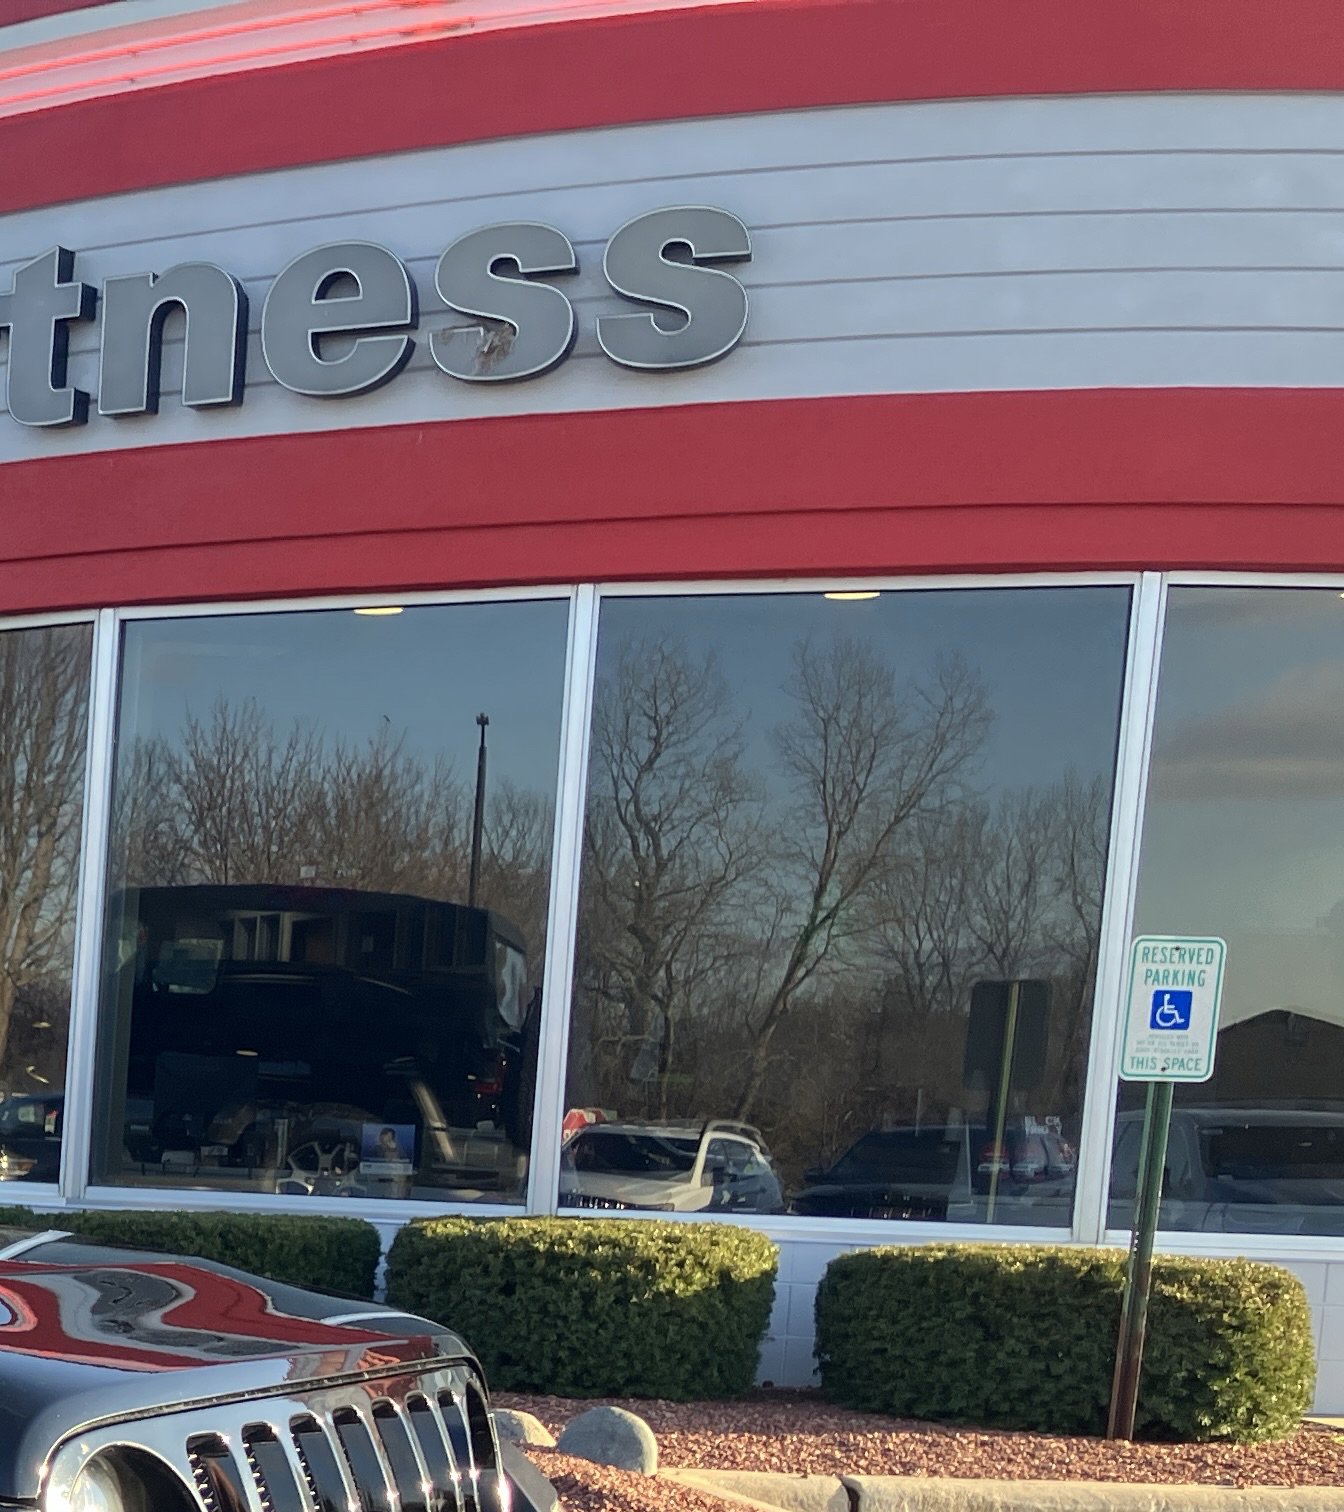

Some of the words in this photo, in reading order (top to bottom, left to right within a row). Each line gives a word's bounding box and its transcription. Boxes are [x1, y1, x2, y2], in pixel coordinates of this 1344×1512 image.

[1141, 946, 1214, 965] RESERVED
[1144, 968, 1206, 987] PARKING
[1130, 1056, 1157, 1071] THIS
[1163, 1057, 1202, 1072] SPACE
